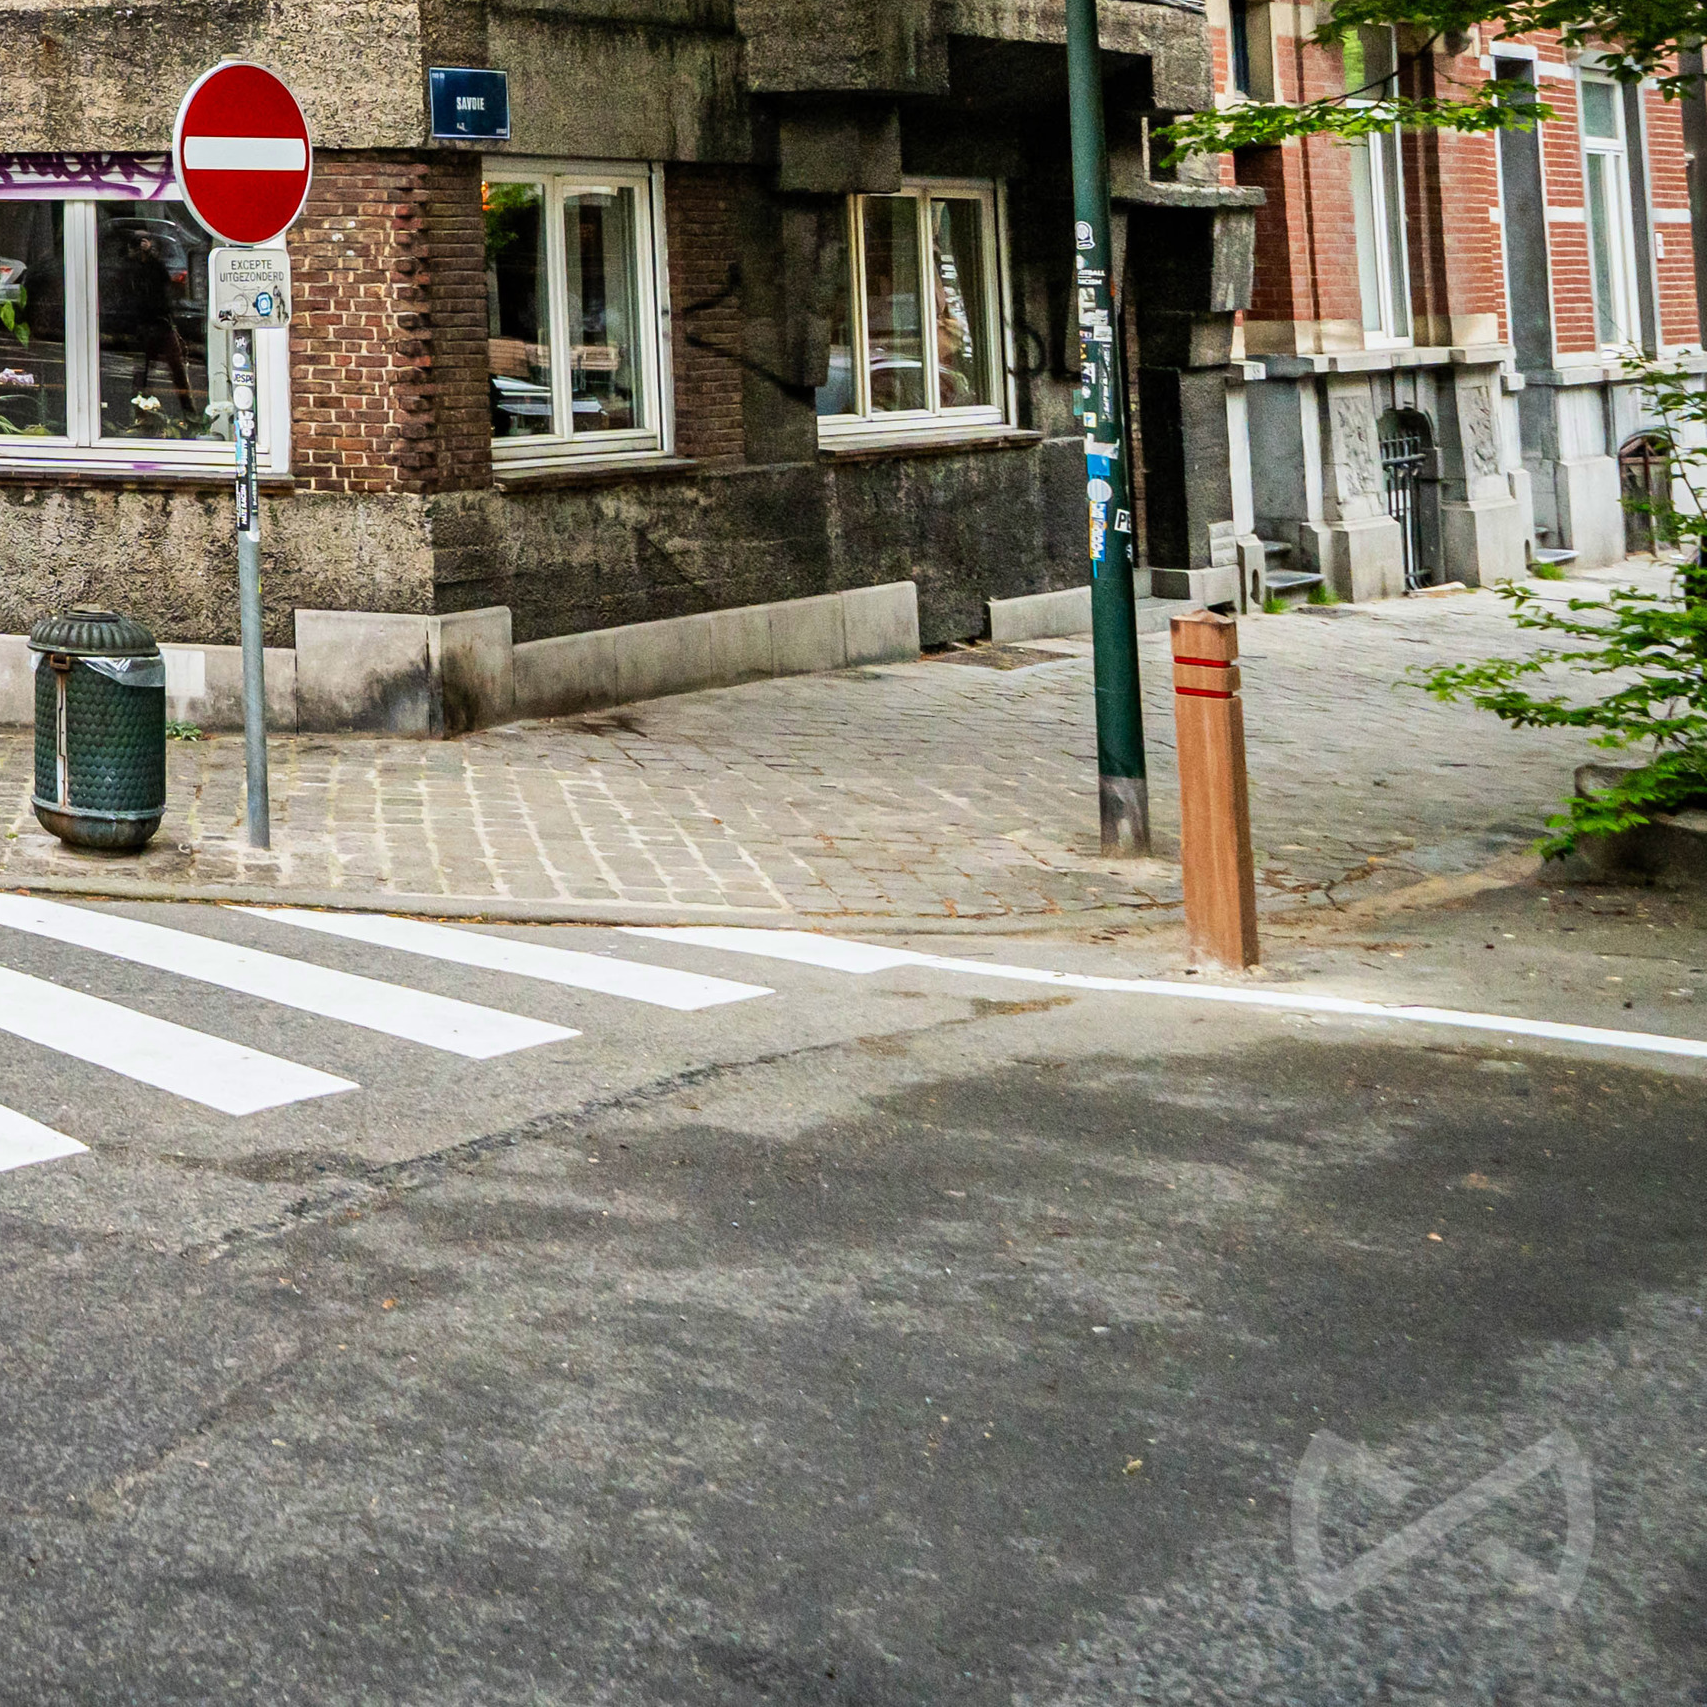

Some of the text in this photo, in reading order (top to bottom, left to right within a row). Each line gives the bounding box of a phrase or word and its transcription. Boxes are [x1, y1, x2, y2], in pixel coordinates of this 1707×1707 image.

[456, 96, 486, 111] SAVOIE
[231, 259, 272, 270] EXCEPTE
[219, 271, 285, 282] UITGEZONDERD
